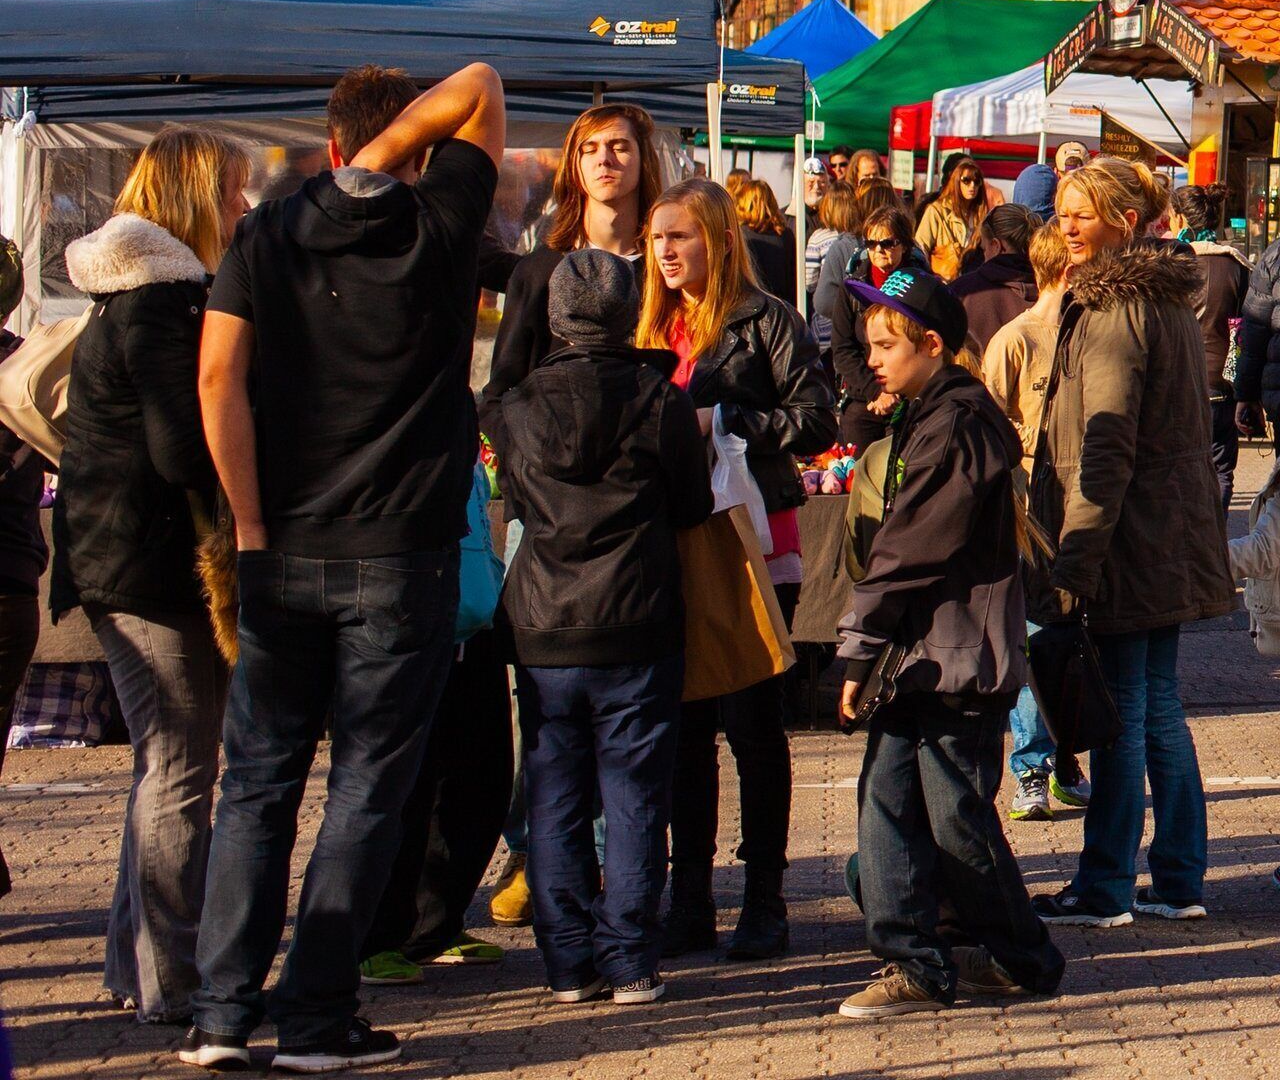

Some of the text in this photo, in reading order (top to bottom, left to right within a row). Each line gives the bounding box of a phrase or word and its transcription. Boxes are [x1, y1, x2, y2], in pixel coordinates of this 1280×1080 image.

[615, 20, 677, 34] OZtrail
[613, 38, 677, 46] Deluxe Gazebo
[1156, 11, 1174, 40] ICE
[1176, 27, 1206, 67] CREAM
[730, 84, 777, 97] OZtrail
